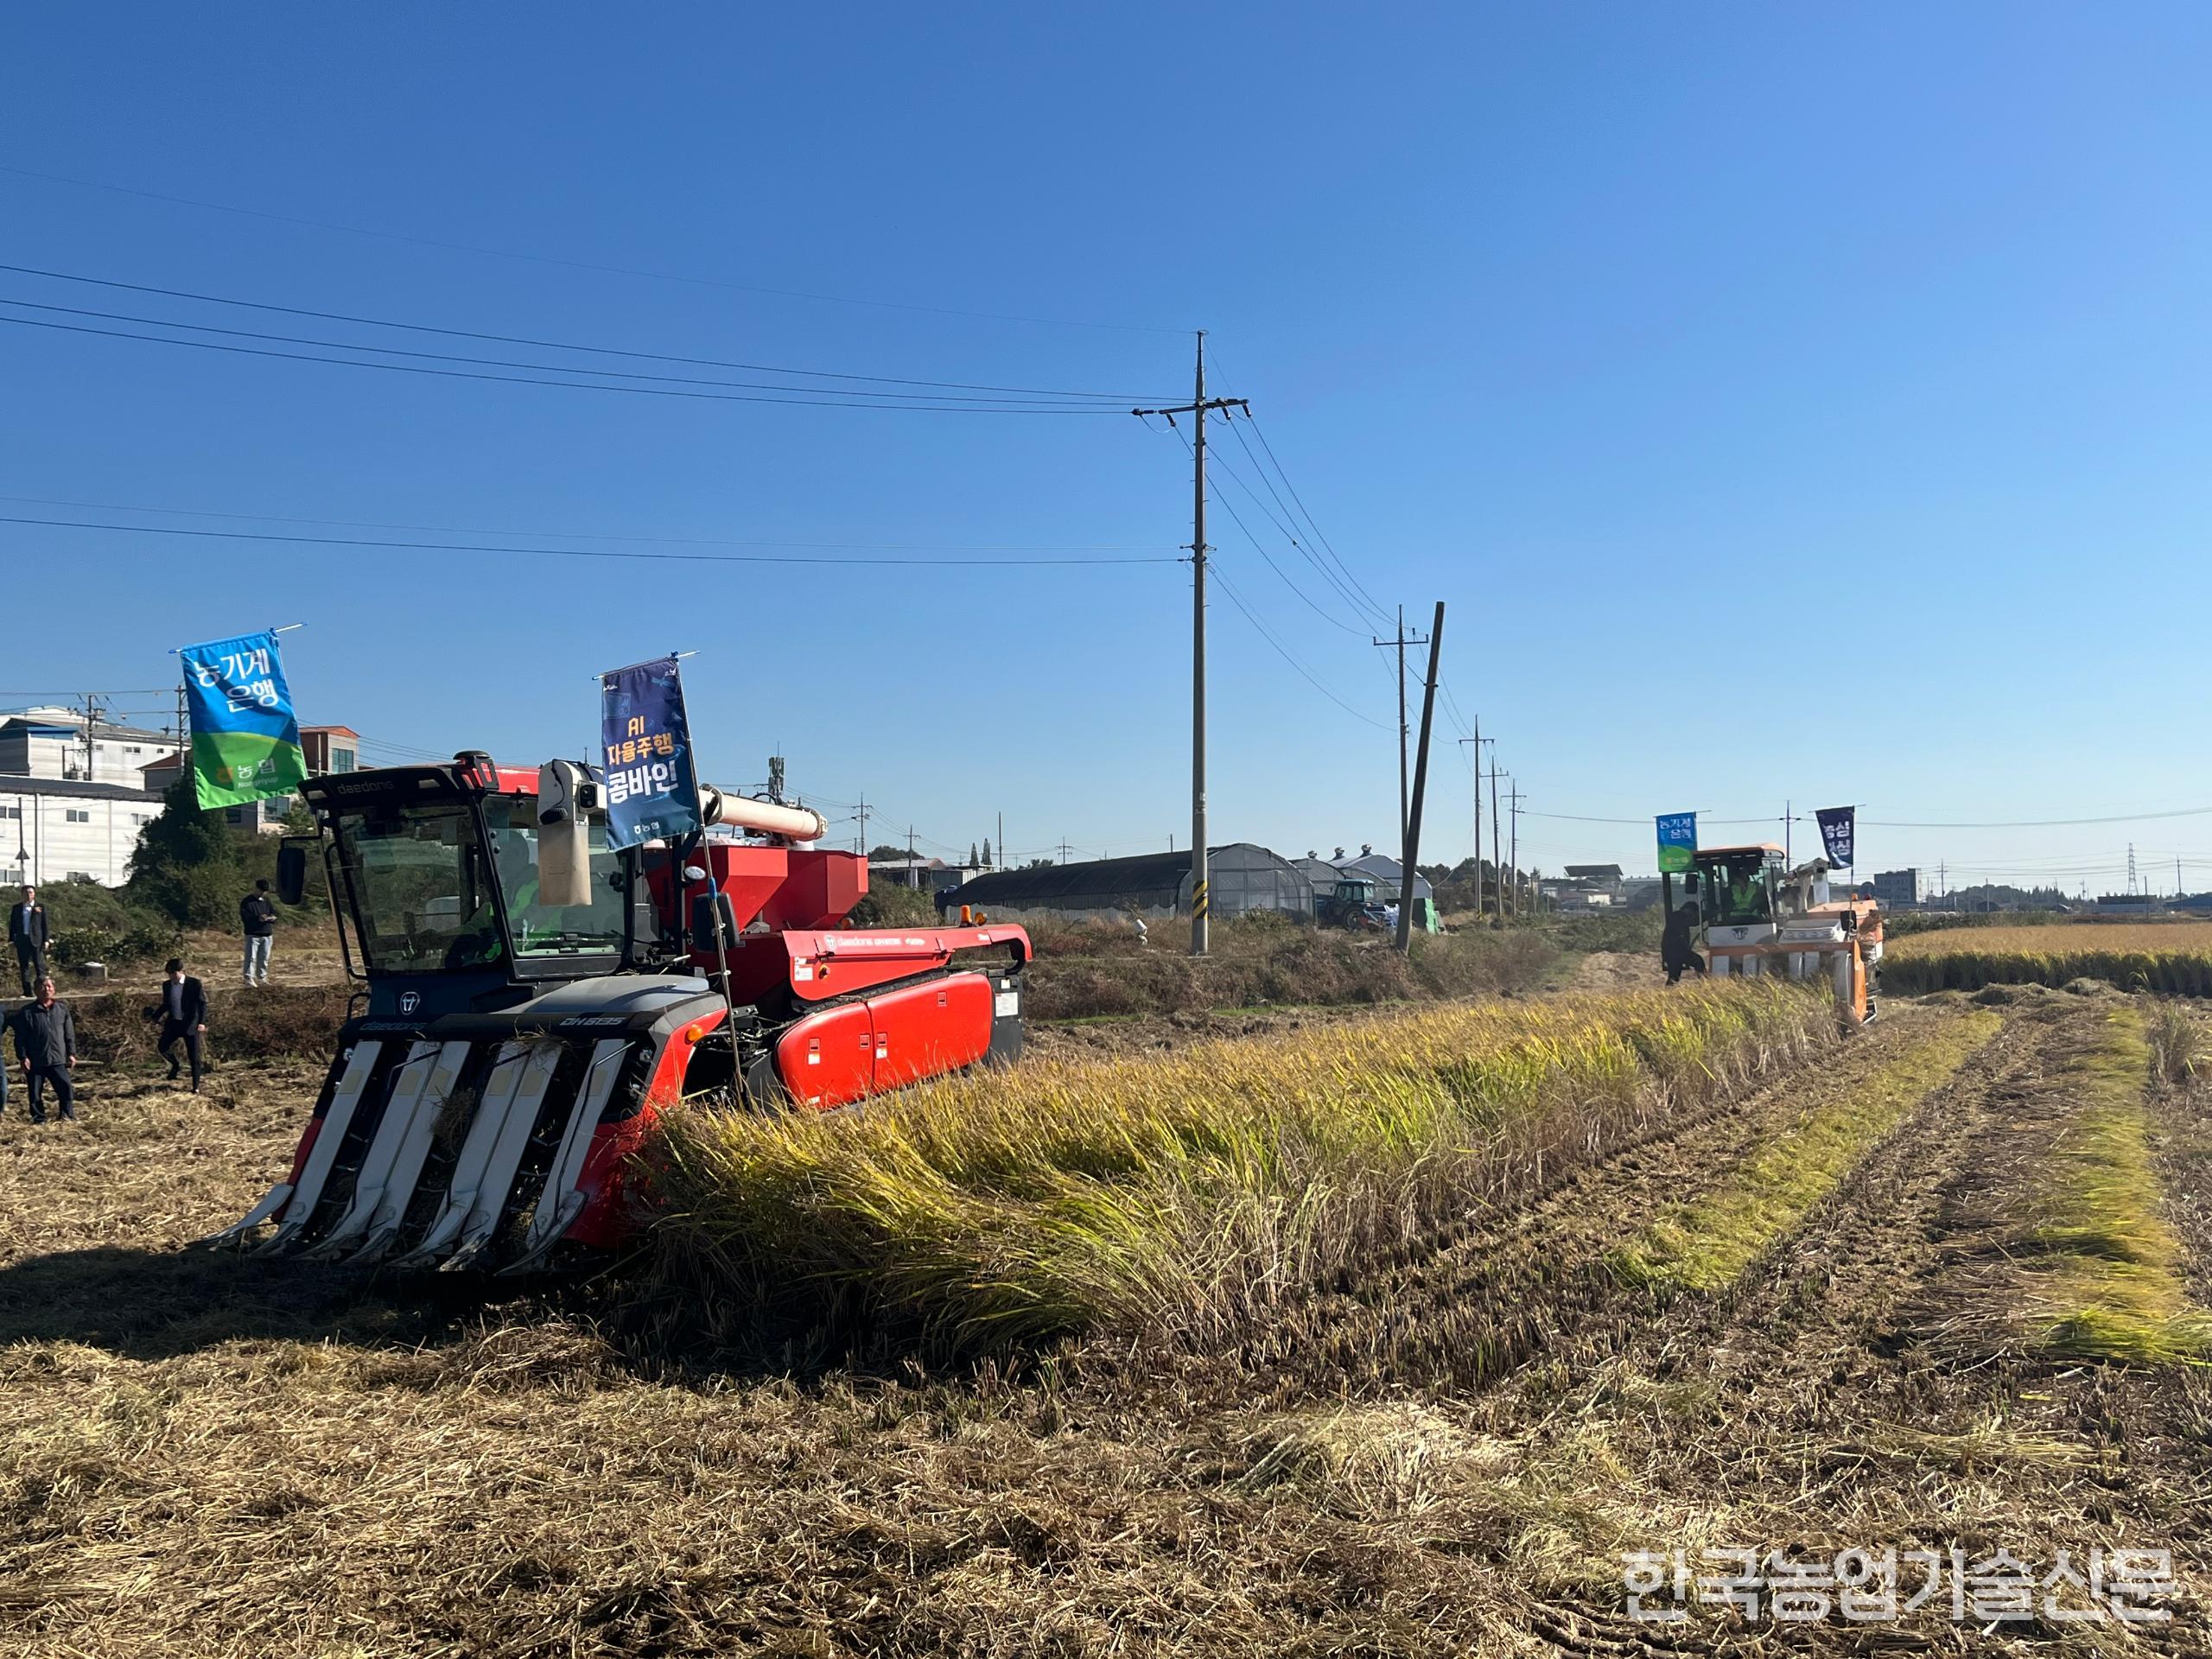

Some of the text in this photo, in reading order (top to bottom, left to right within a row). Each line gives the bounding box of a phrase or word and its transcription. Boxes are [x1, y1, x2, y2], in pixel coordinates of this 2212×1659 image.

[194, 648, 270, 688] 농기계
[226, 678, 279, 713] 은행
[629, 715, 645, 737] AI
[607, 733, 674, 766] 자율주행
[237, 758, 276, 779] 농협
[607, 760, 679, 804] 콤바인
[337, 780, 395, 795] daedong
